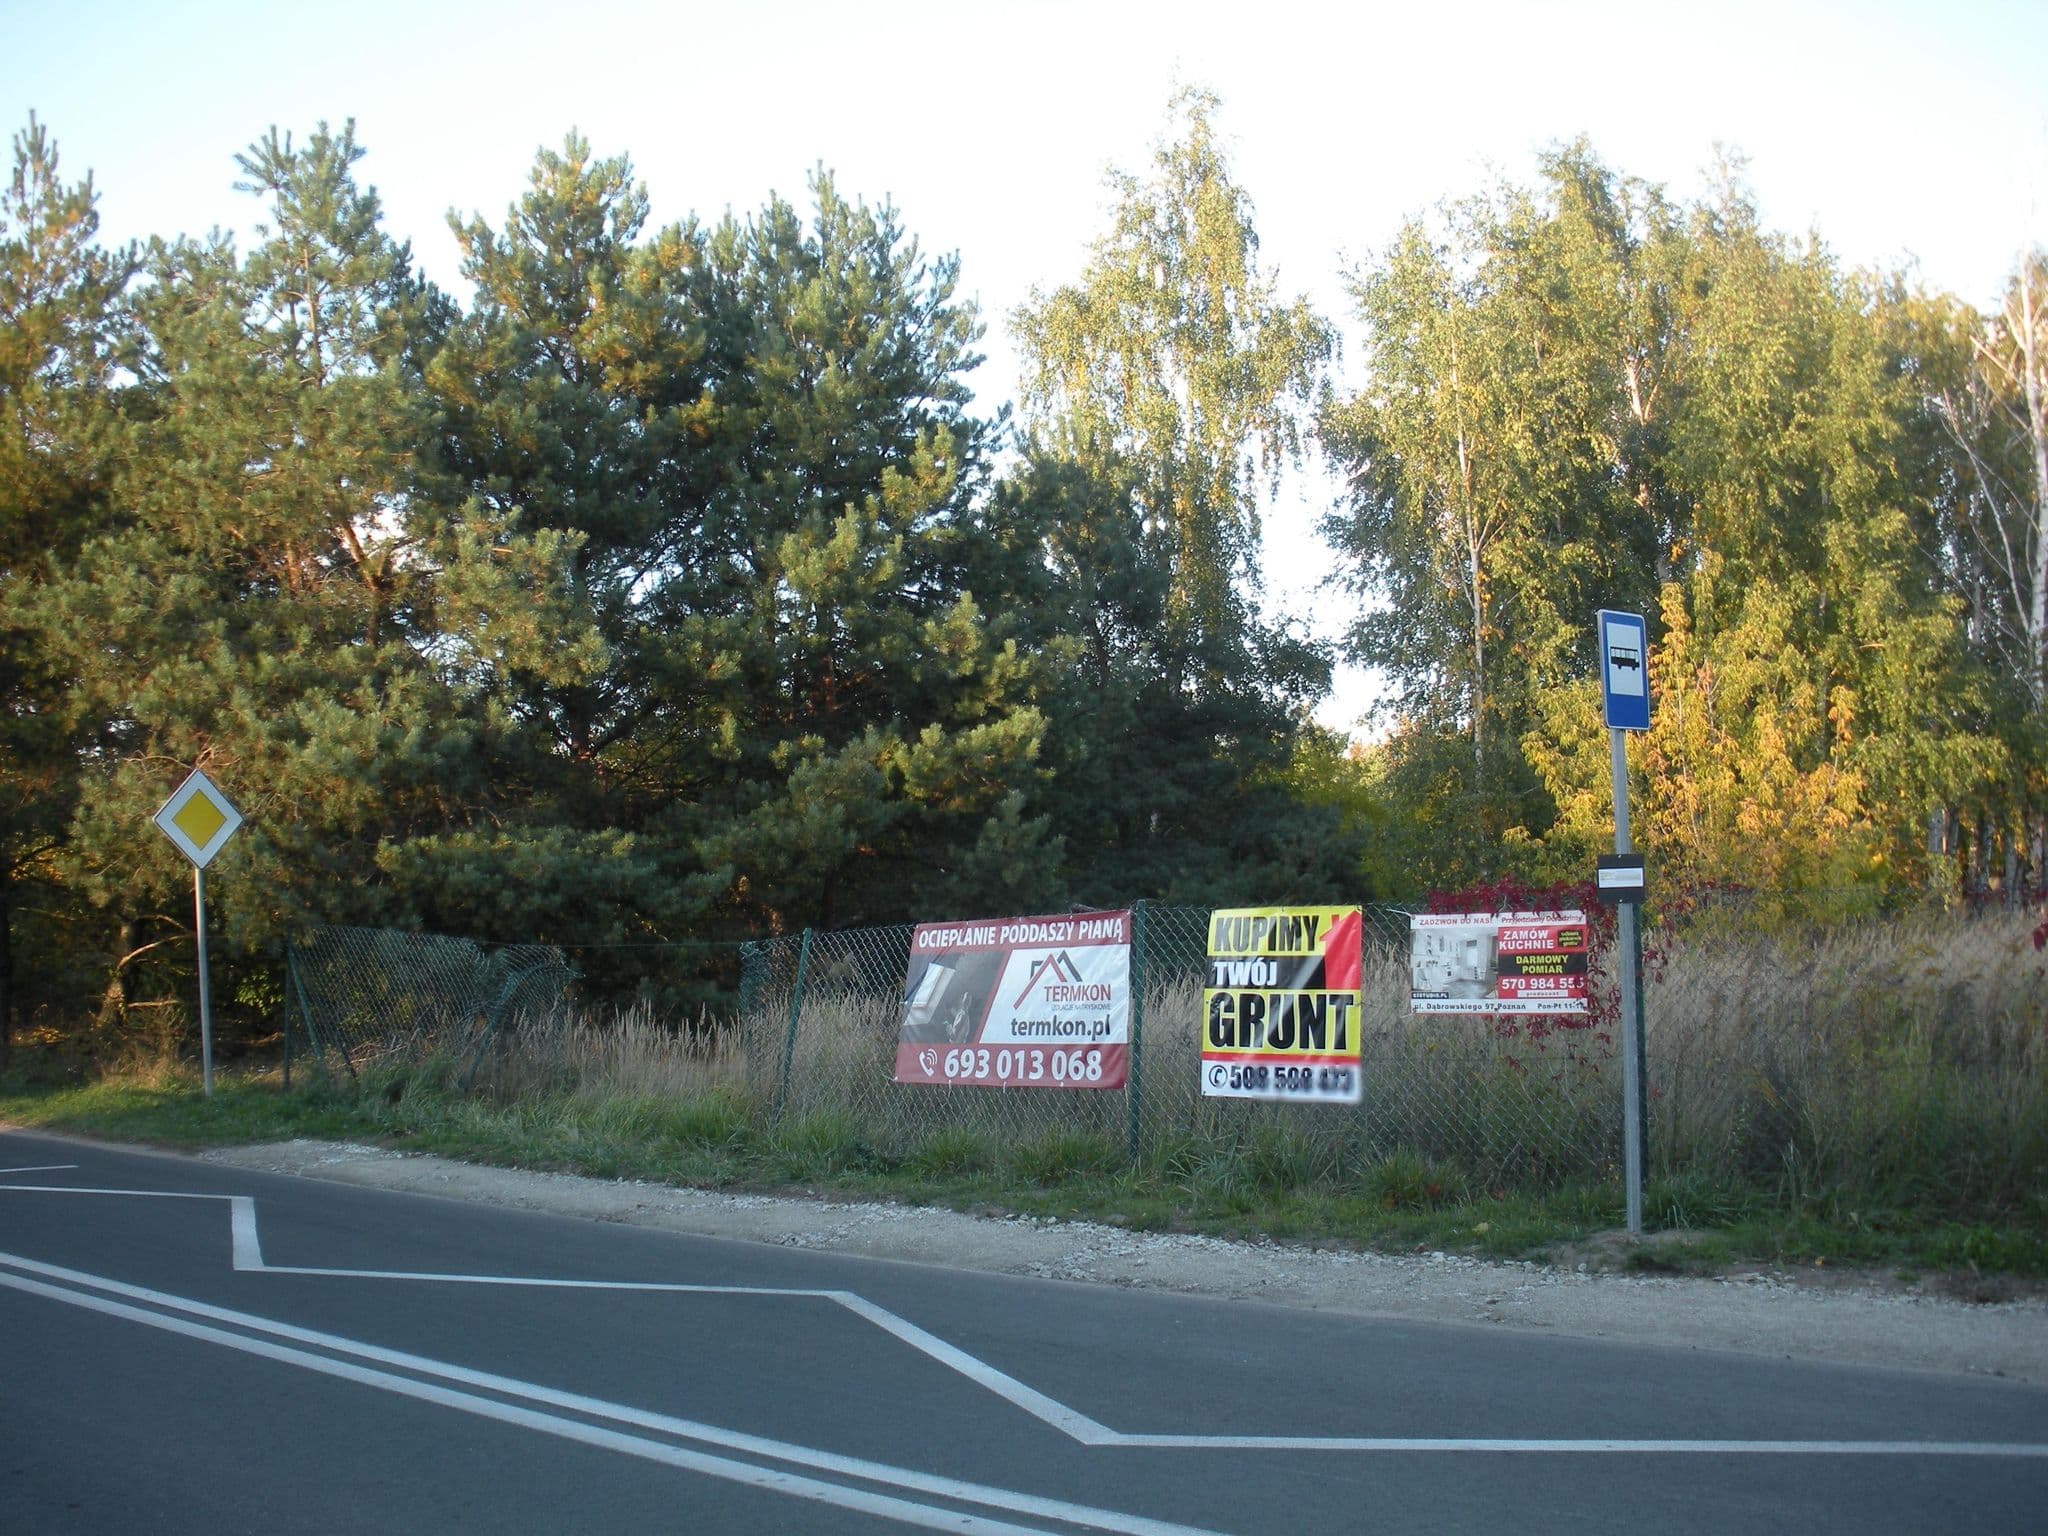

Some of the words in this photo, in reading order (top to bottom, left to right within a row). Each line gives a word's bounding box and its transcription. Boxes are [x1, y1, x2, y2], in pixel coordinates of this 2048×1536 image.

[918, 927, 996, 948] OCIEPLANIE
[1000, 922, 1073, 943] PODDASZY
[1078, 917, 1124, 943] PIANĄ
[1213, 915, 1319, 952] KUPIMY
[1504, 929, 1548, 939] ZAMÓW
[1499, 940, 1554, 950] KUCHNIE
[1516, 955, 1569, 964] DARMOWY
[1213, 957, 1277, 986] TWÓJ
[1522, 964, 1563, 974] POMIAR
[1501, 979, 1526, 989] 570
[1530, 978, 1555, 989] 984
[1044, 984, 1111, 1001] TERMKON
[1426, 1003, 1482, 1011] Dąbrowskiego
[1011, 1014, 1110, 1041] termkon.pl
[1209, 992, 1354, 1050] GRUNT
[944, 1048, 990, 1079] 693
[996, 1049, 1044, 1080] 013
[1051, 1049, 1103, 1081] 068
